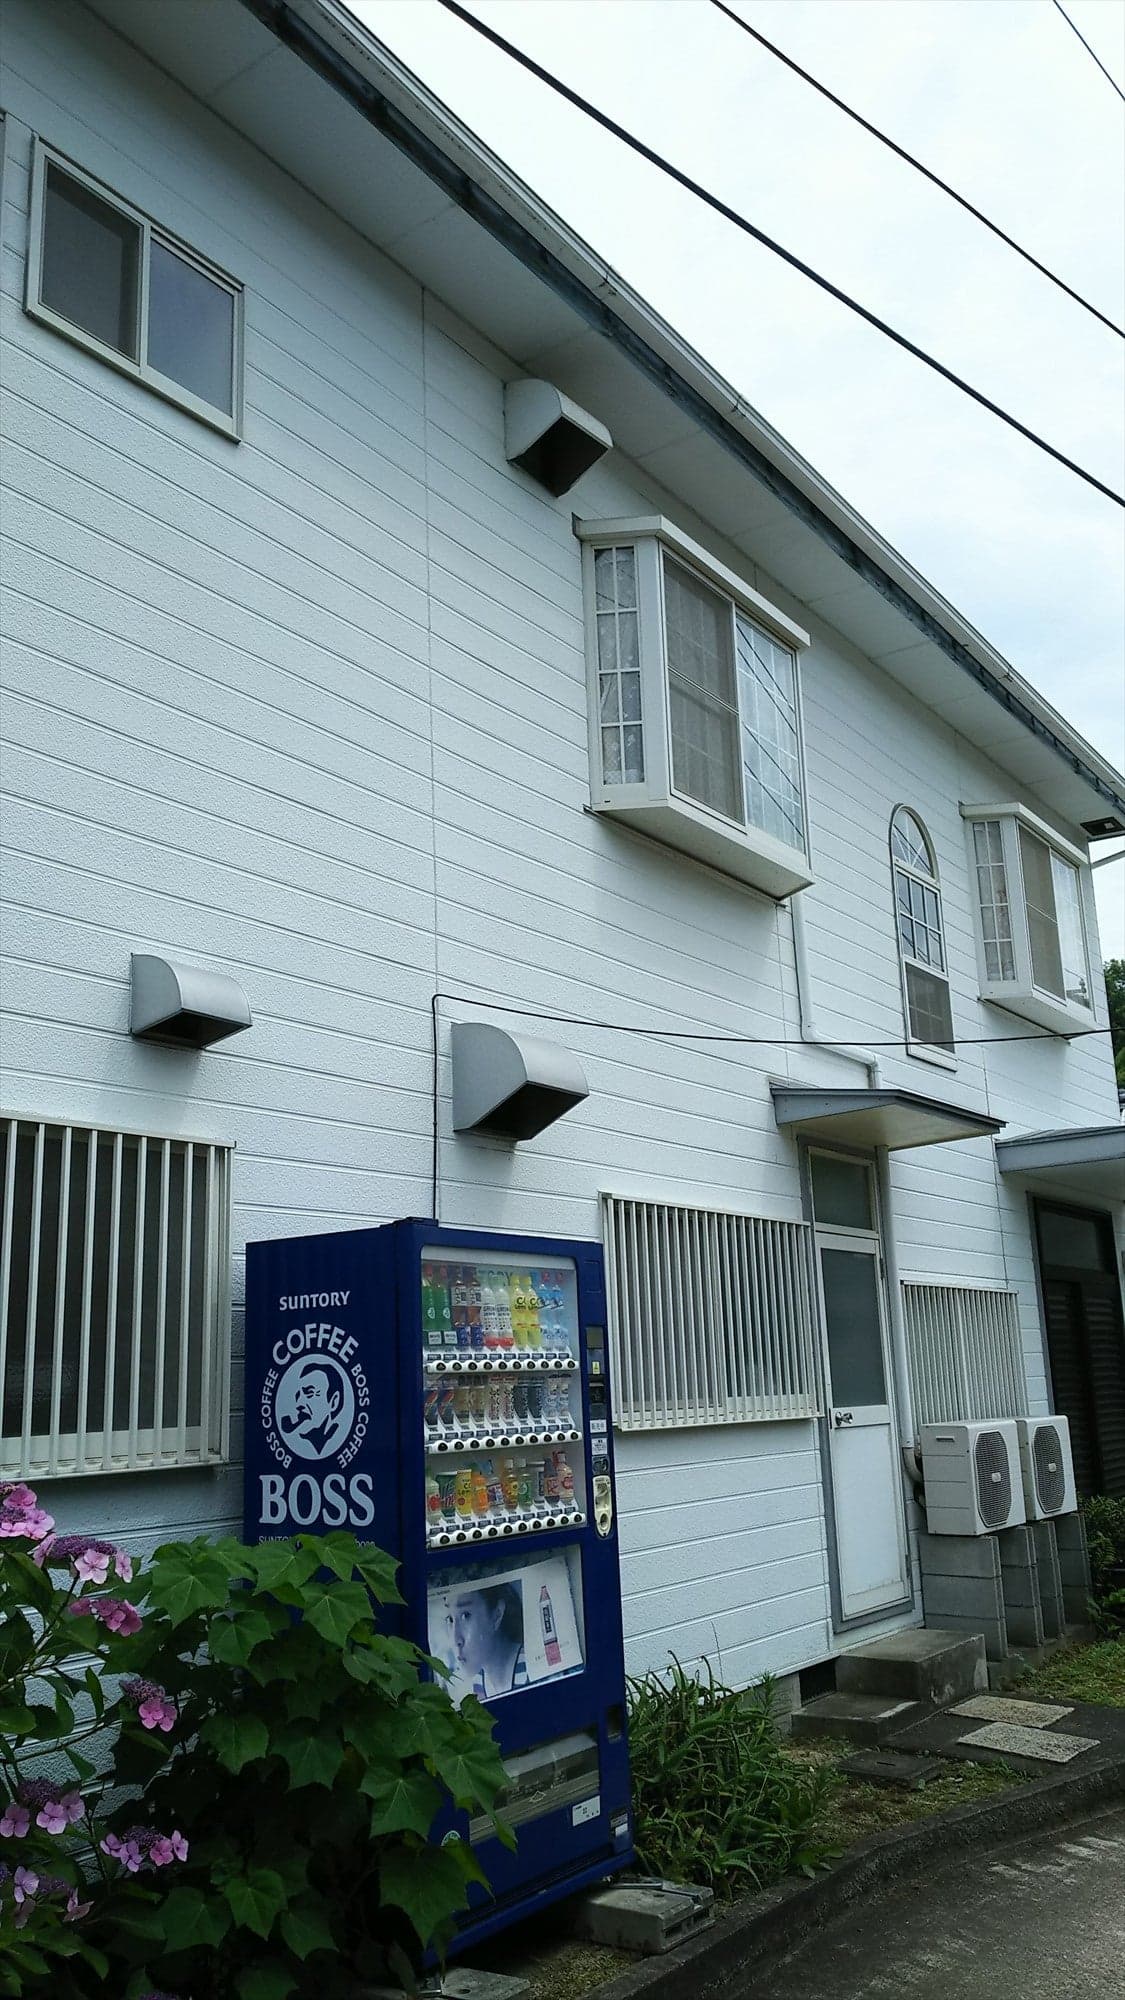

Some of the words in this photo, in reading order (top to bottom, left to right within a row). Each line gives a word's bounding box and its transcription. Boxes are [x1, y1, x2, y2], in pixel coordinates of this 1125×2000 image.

[279, 1290, 351, 1311] SUNTORY
[272, 1323, 360, 1366] COFFEE
[261, 1368, 280, 1429] COFFEE
[350, 1363, 370, 1407] BOSS
[266, 1431, 293, 1469] BOSS
[337, 1411, 370, 1469] COFFEE
[258, 1473, 375, 1527] BOSS
